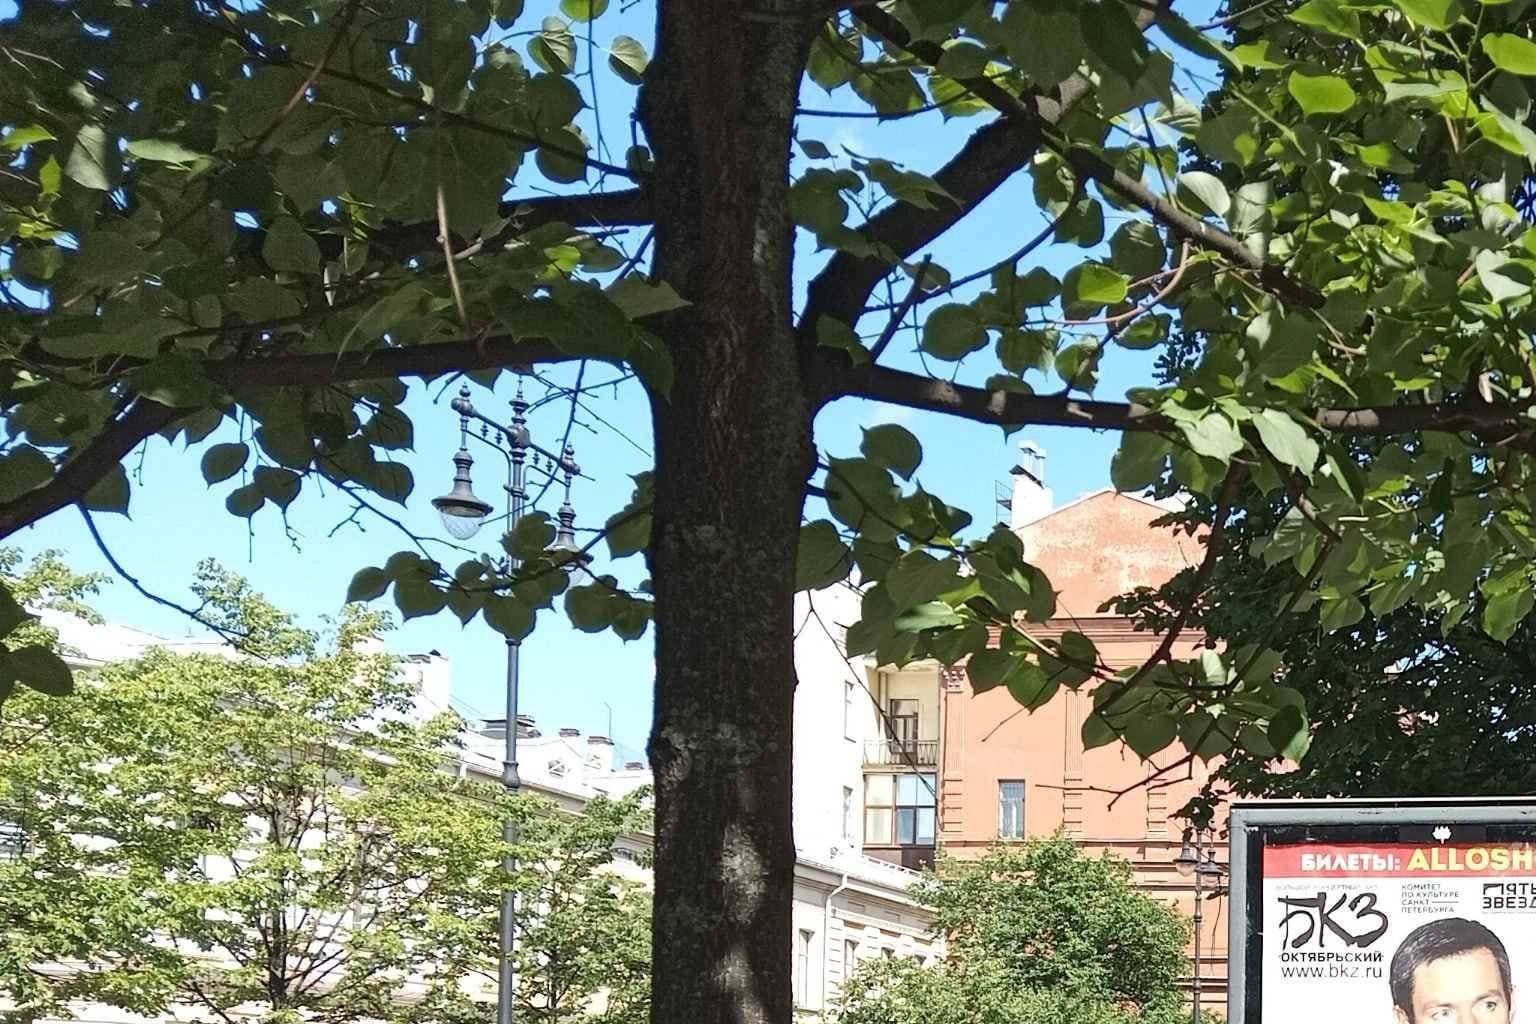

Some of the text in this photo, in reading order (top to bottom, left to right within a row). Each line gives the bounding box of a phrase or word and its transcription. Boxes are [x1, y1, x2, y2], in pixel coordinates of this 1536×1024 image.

[1301, 853, 1400, 872] БИЛЕТЫ:
[1278, 892, 1388, 950] БКЗ
[1281, 951, 1383, 962] ОКТЯБРЬСКИЙ
[1281, 963, 1383, 978] www.bkz.ru
